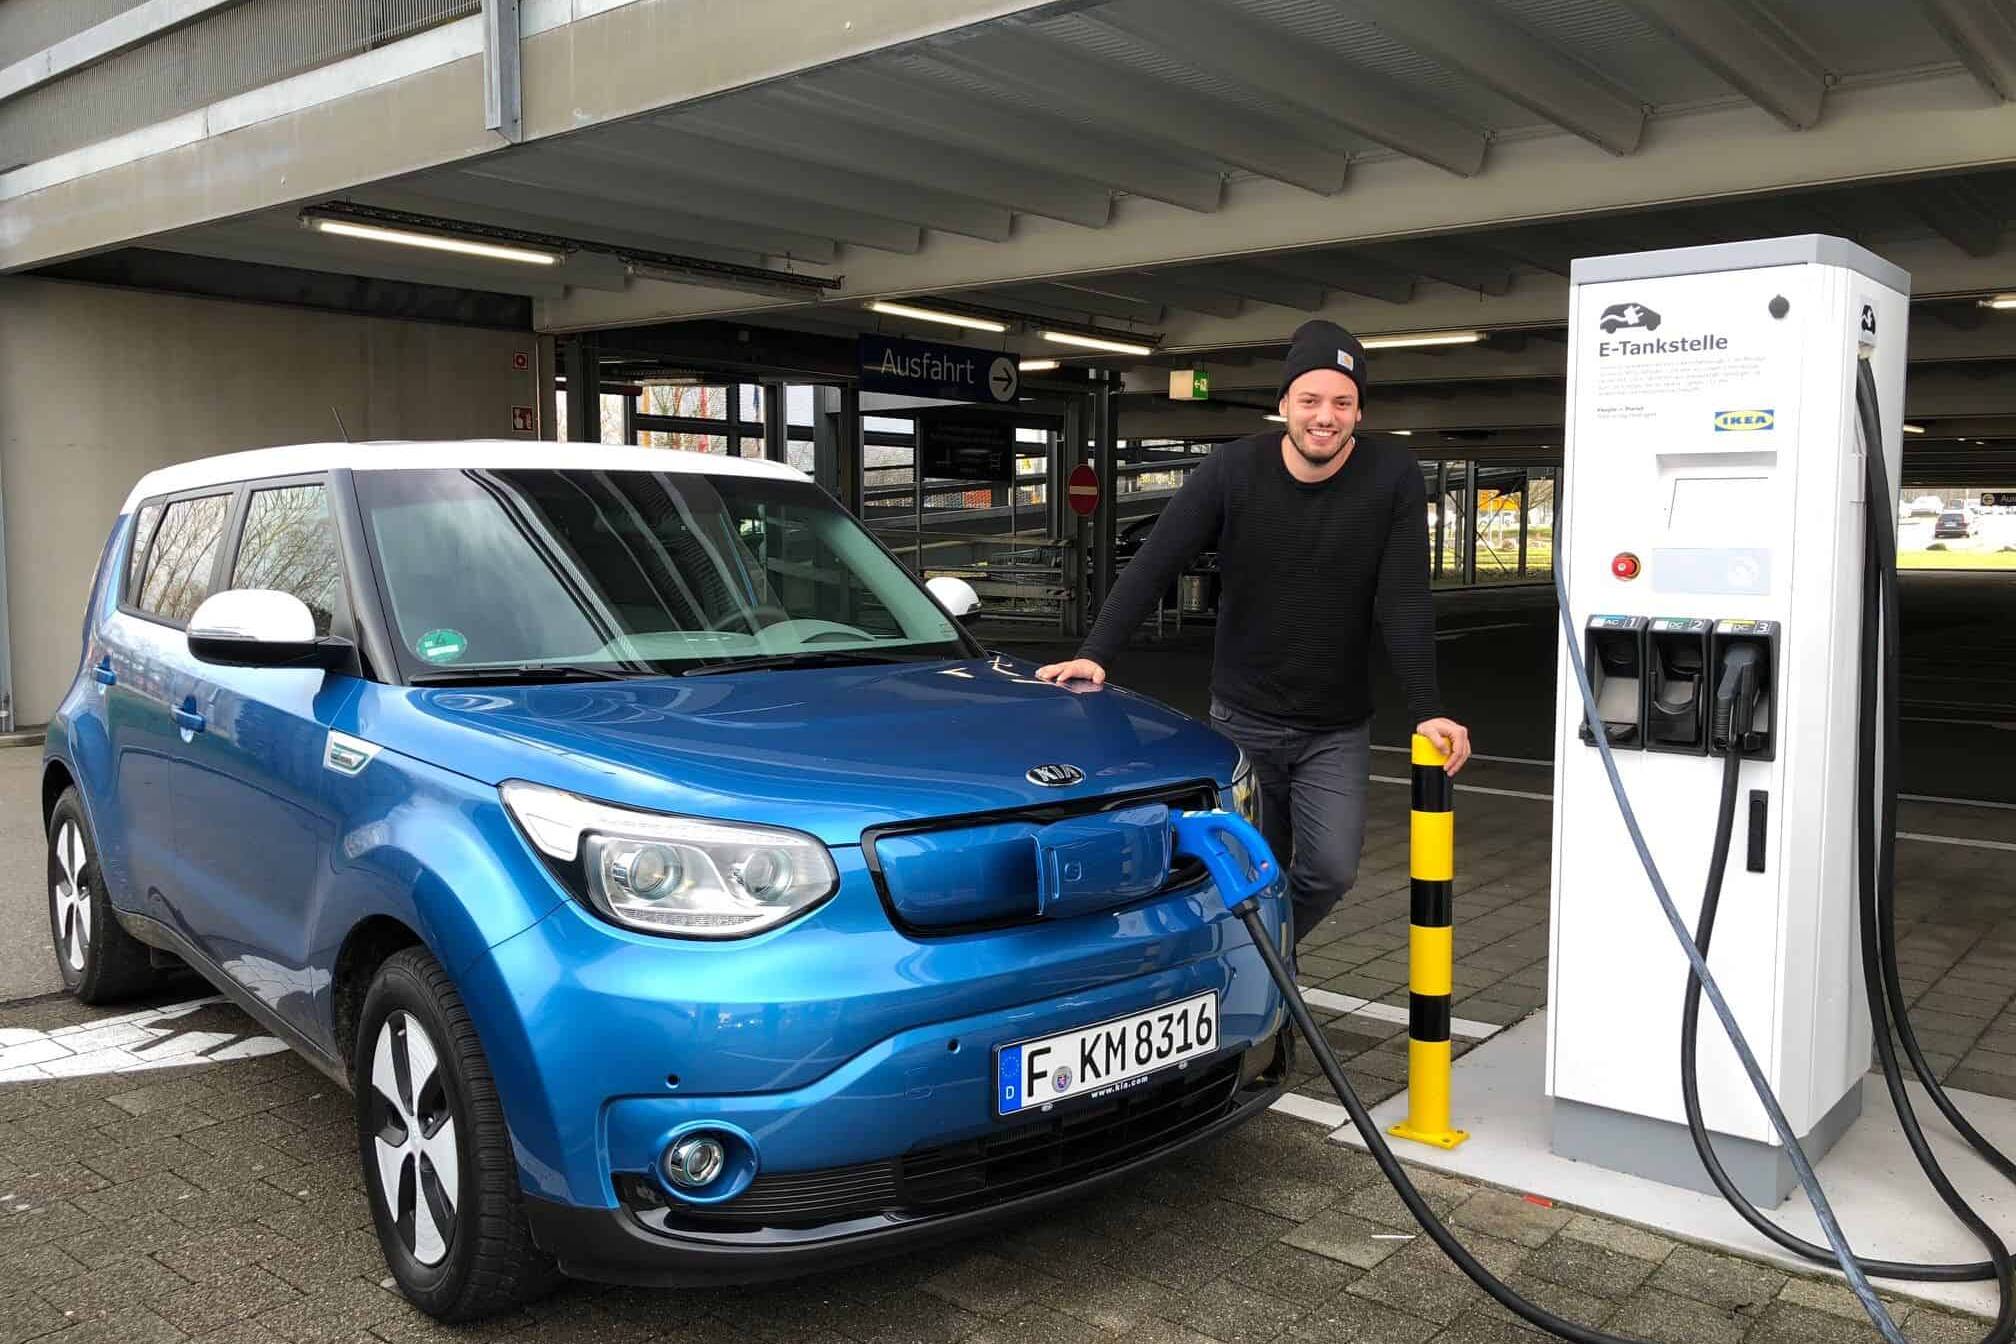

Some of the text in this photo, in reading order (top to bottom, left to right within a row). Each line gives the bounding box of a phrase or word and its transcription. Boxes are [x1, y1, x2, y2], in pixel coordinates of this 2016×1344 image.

[1599, 334, 1728, 357] E-Tankstelle
[881, 348, 975, 385] Ausfahrt
[1722, 415, 1768, 426] IKEA
[1691, 620, 1703, 630] 2
[1758, 621, 1769, 634] 3
[1027, 1002, 1213, 1098] F KM 8316
[1005, 1085, 1015, 1100] D
[1091, 1075, 1149, 1099] www.kia.com
